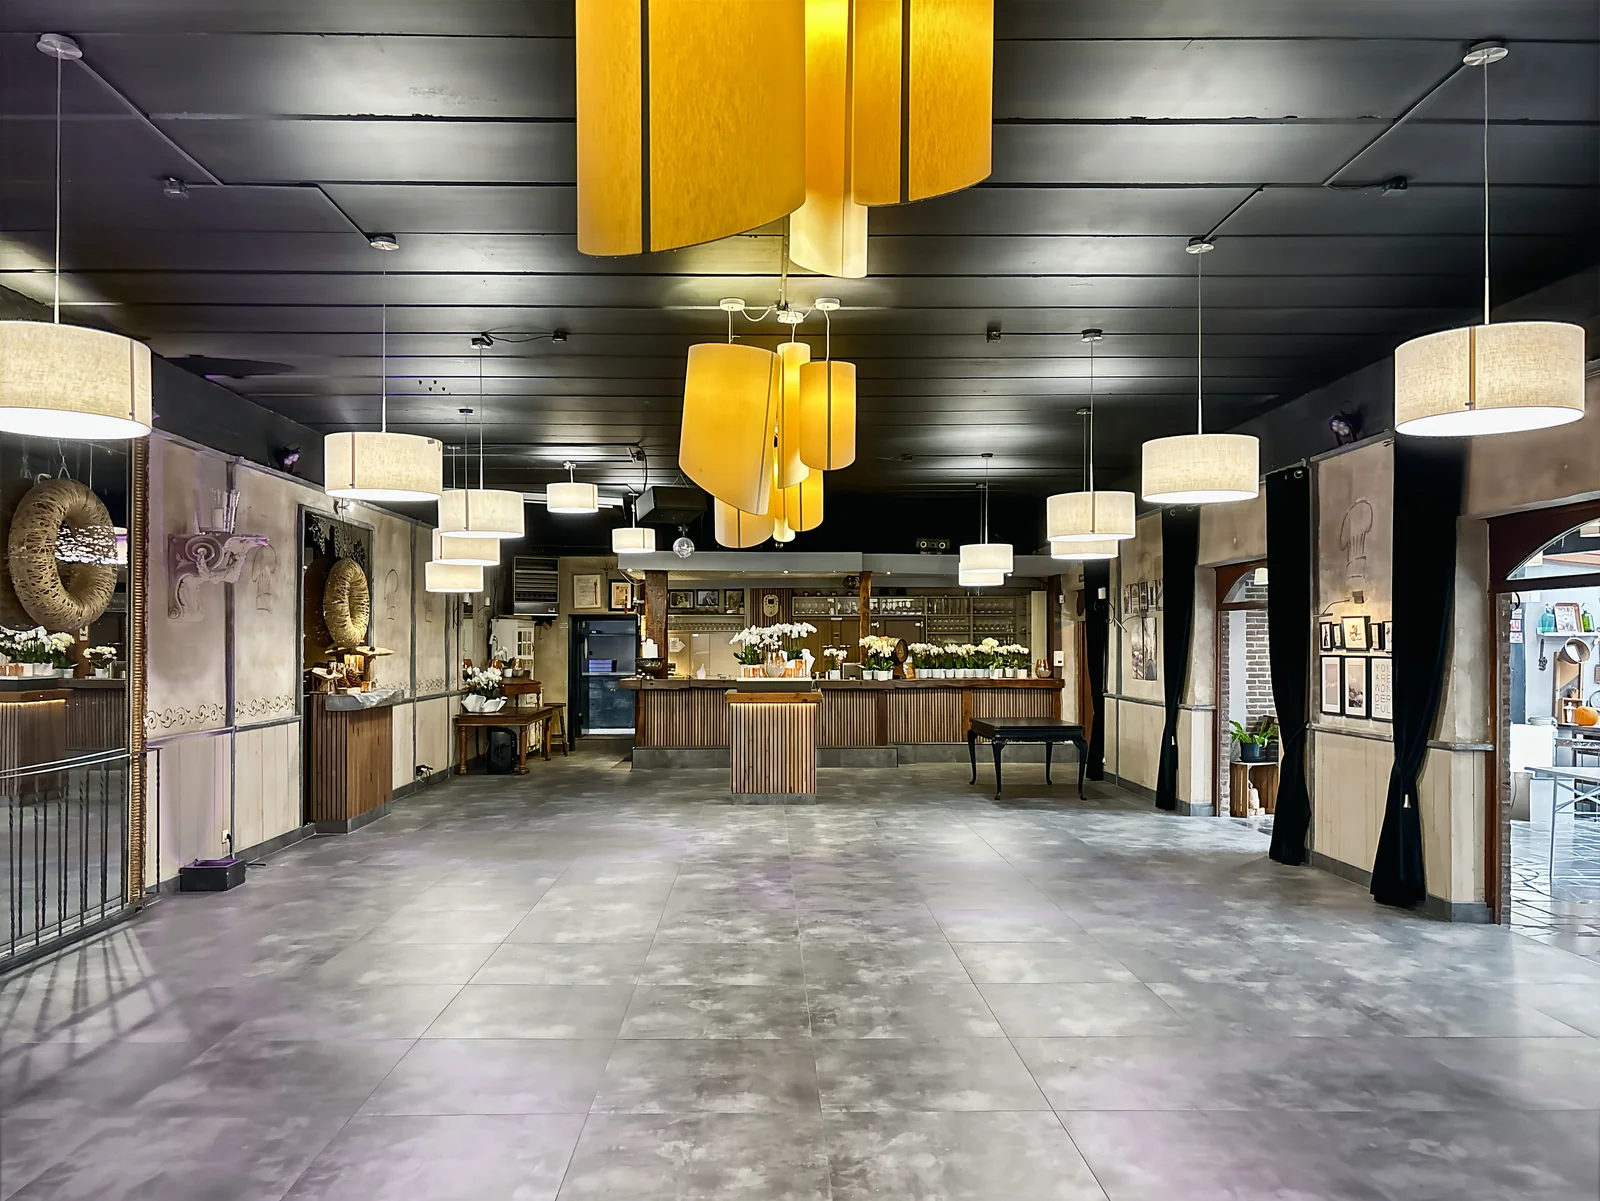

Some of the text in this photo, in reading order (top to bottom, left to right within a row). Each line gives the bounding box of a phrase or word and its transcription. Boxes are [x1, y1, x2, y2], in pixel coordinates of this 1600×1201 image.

[1375, 674, 1391, 683] ARE
[1375, 694, 1391, 703] DER
[1375, 704, 1391, 714] FUL
